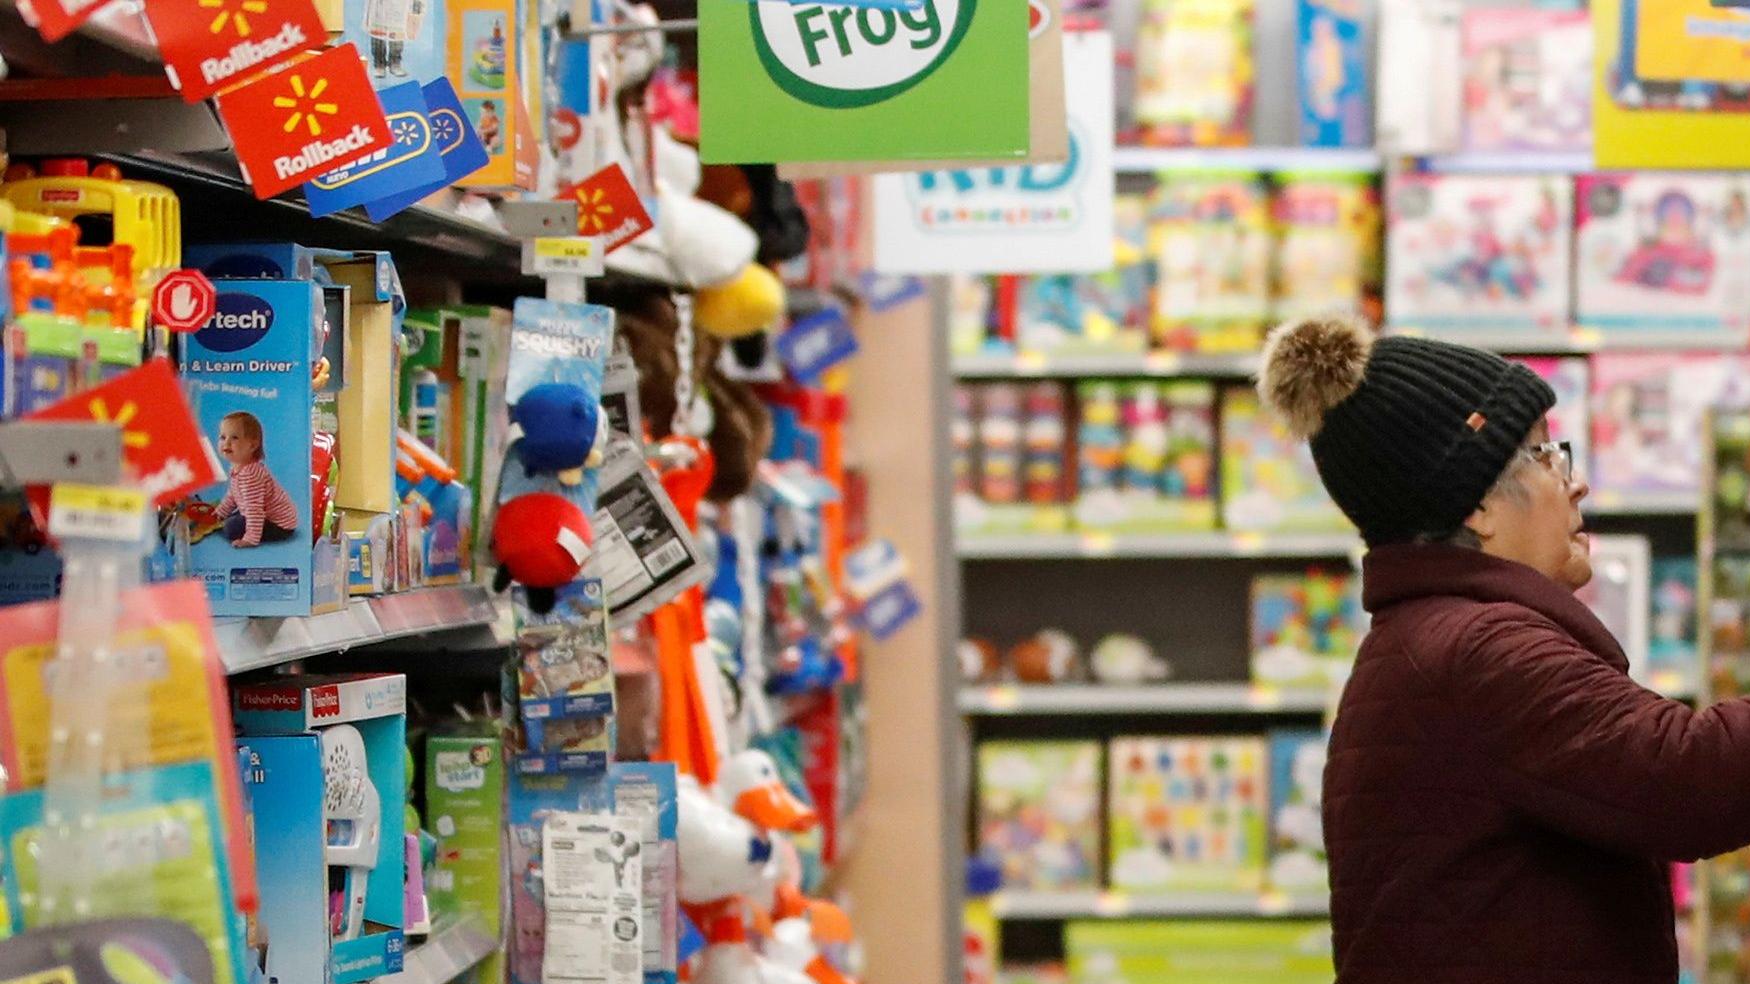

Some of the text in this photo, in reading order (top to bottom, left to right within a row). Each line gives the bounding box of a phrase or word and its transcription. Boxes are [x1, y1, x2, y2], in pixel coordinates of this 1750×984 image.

[200, 21, 307, 85] Rollback
[793, 3, 942, 68] Frog
[273, 123, 374, 181] Rollback
[191, 359, 292, 373] & Learn Driver
[243, 693, 297, 706] Fisher-Price
